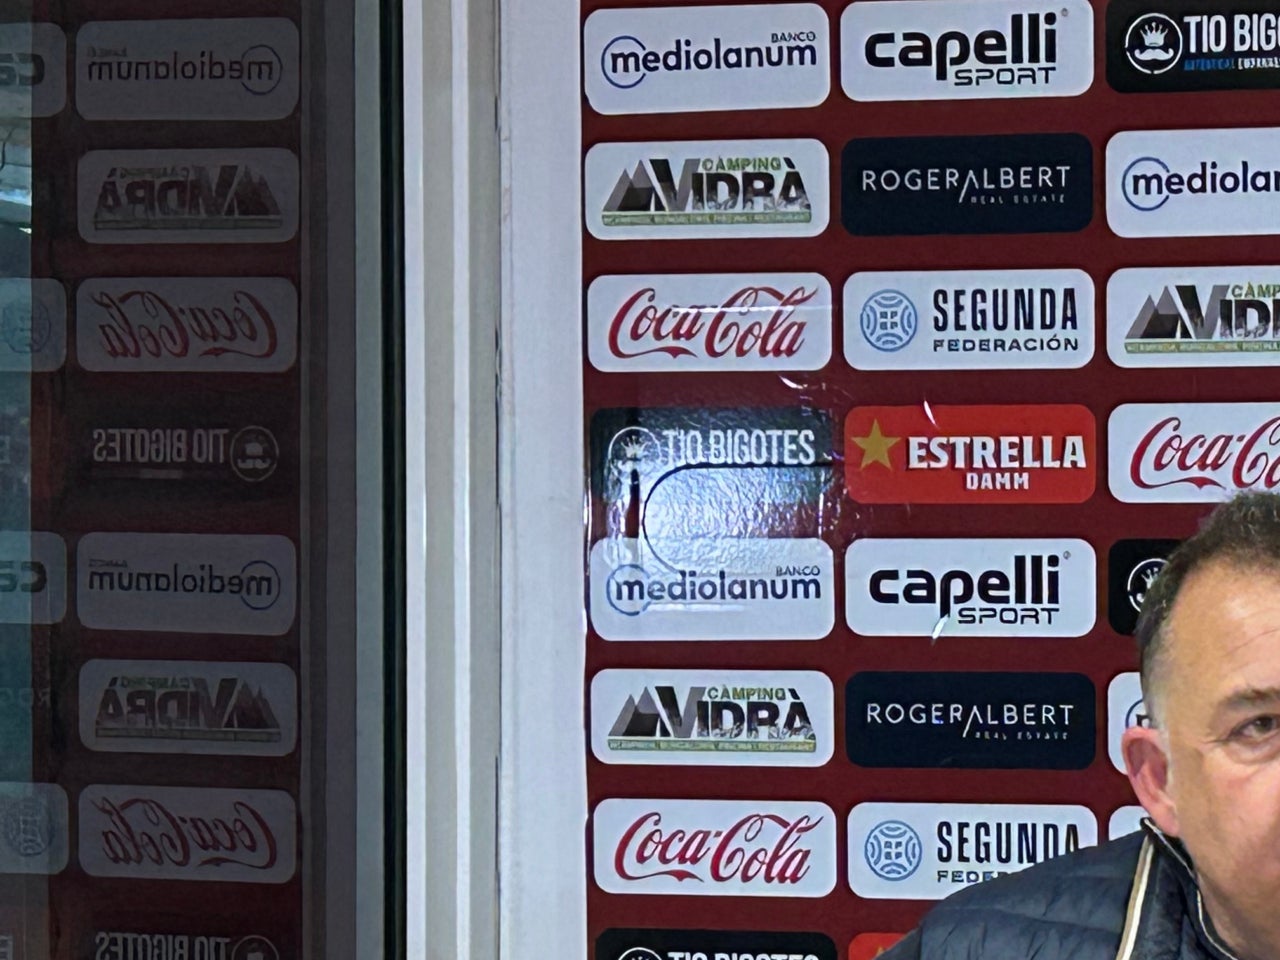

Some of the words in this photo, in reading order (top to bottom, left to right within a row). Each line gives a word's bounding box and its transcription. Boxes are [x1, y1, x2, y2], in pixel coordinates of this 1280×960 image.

[771, 32, 816, 42] BANCO
[865, 12, 1057, 81] capelli
[1184, 15, 1227, 52] TIO
[611, 38, 816, 73] mediolanum
[955, 68, 1056, 85] SPORT
[933, 288, 1077, 331] SEGUNDA
[933, 335, 1078, 352] FEDERACIÓN
[909, 436, 1086, 470] ESTRELLA
[966, 472, 1029, 490] DAMM
[616, 571, 821, 600] mediolanum
[776, 565, 820, 576] BANCO
[869, 555, 1060, 617] capelli
[958, 607, 1059, 624] SPORT
[937, 821, 1079, 864] SEGUNDA
